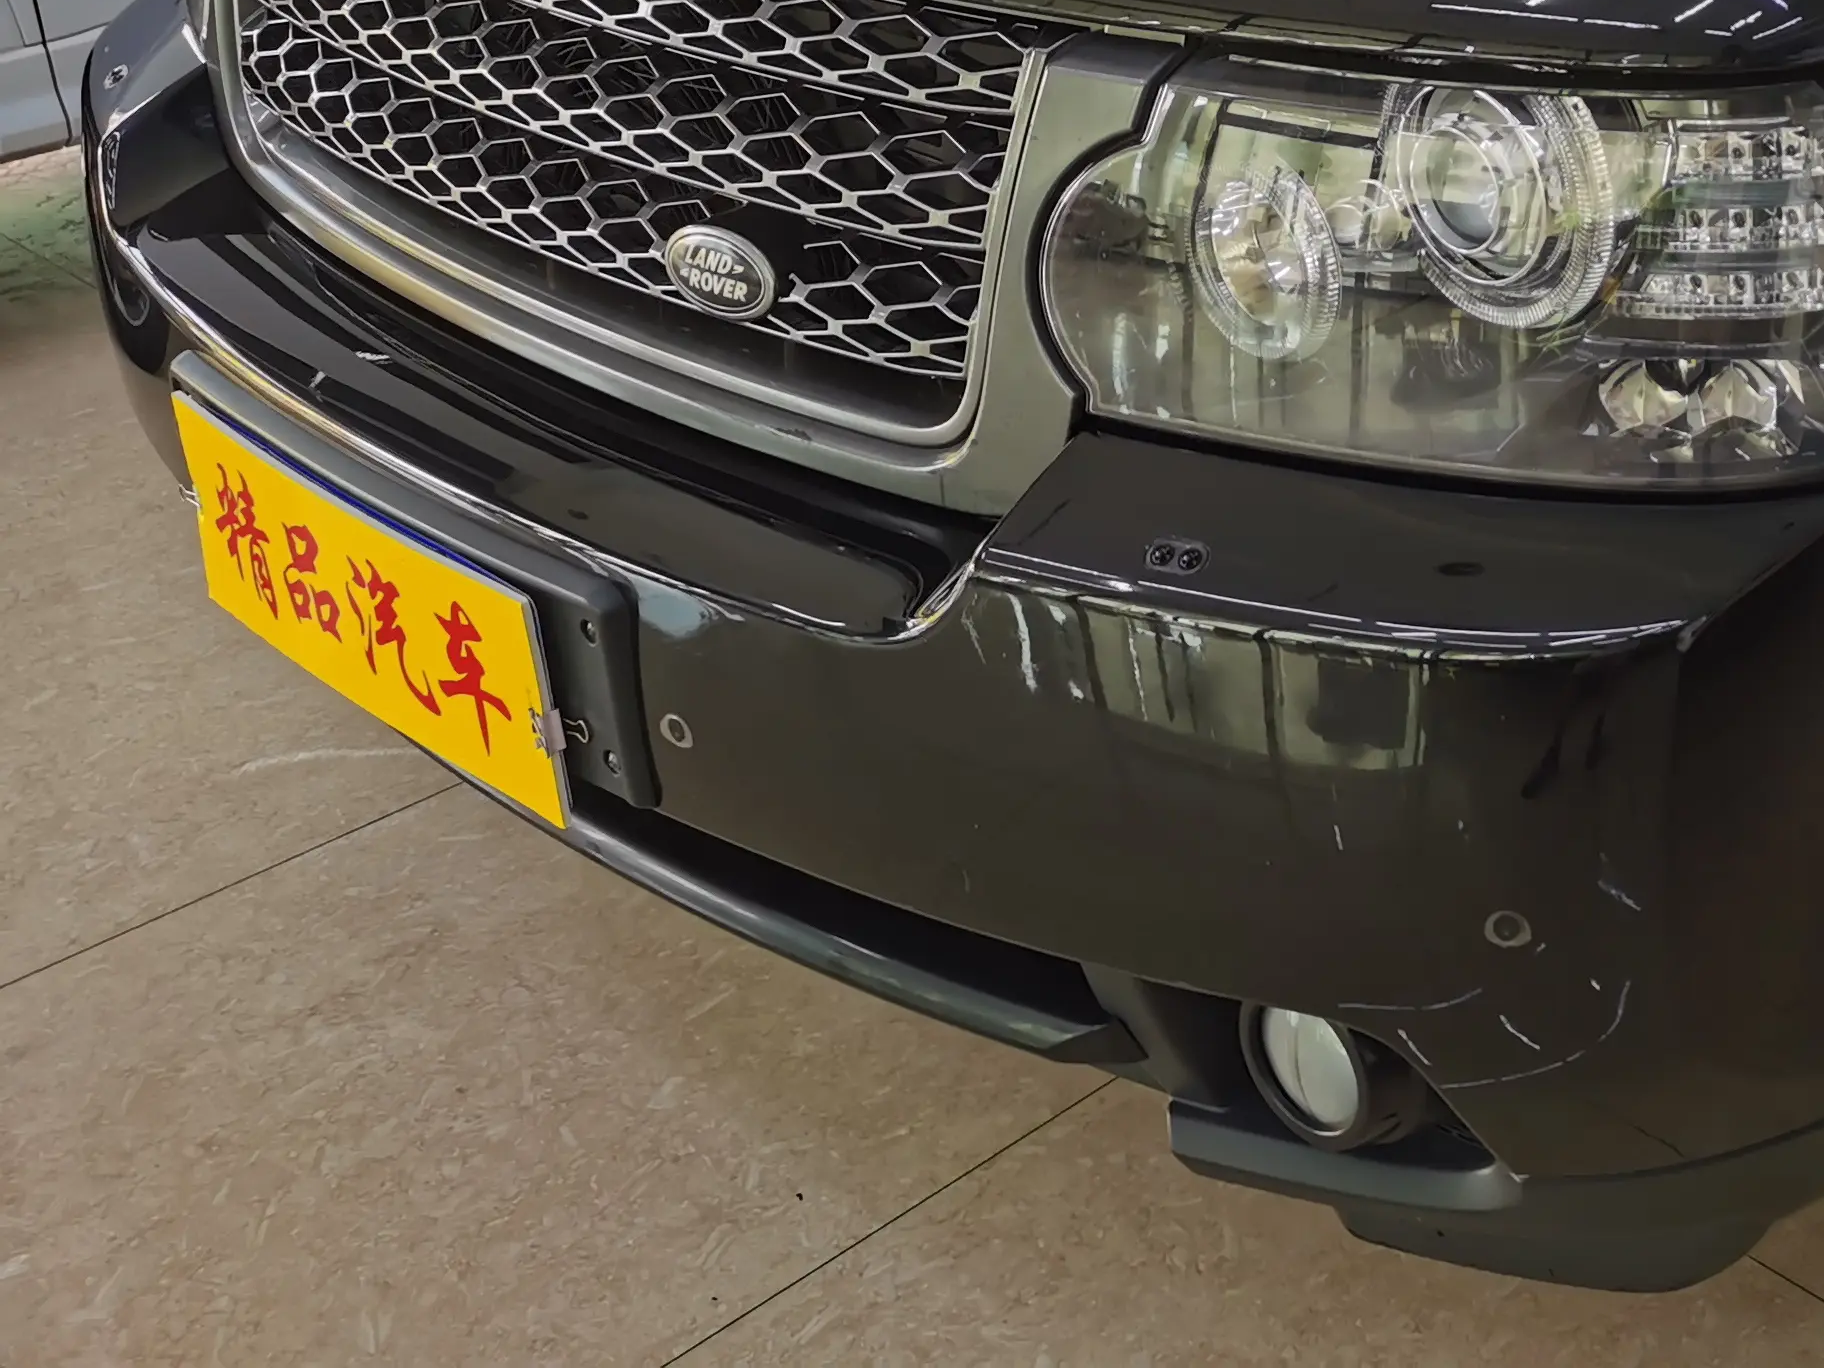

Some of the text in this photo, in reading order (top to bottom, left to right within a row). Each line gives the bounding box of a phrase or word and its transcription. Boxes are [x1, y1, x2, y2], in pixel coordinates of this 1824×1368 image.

[684, 244, 733, 275] LAND
[688, 268, 748, 303] ROVER
[215, 463, 512, 757] 精品汽车
